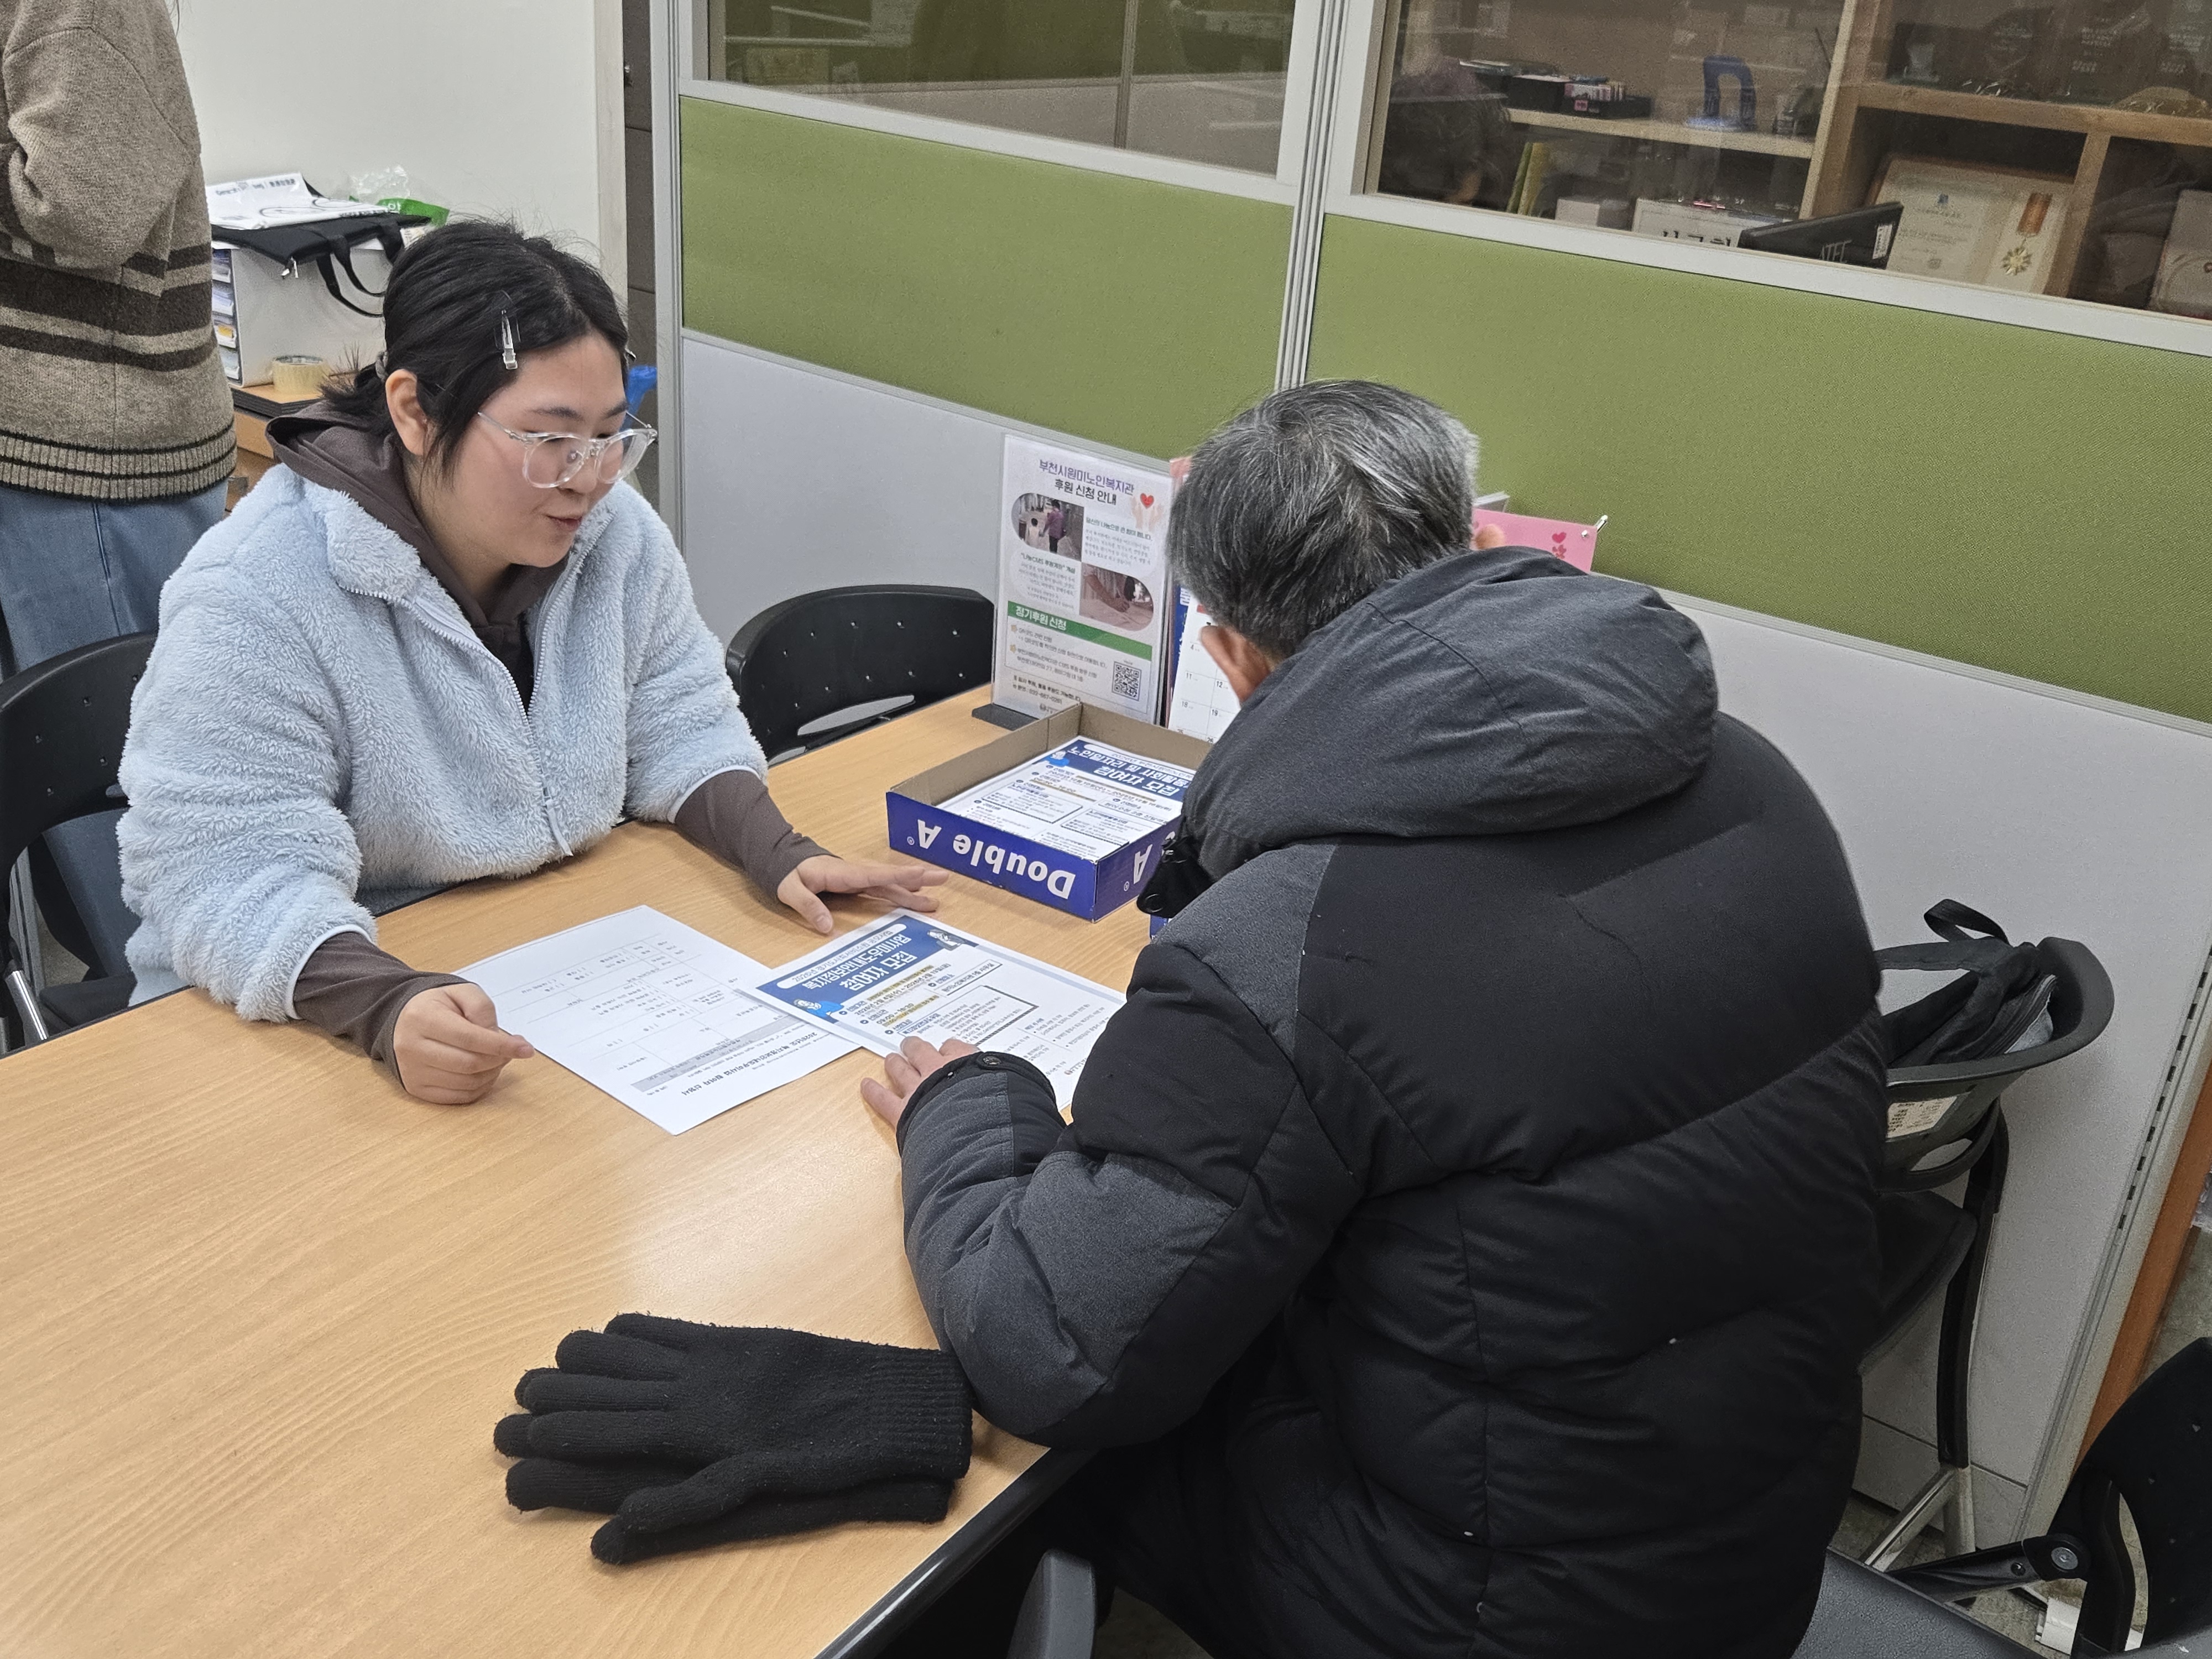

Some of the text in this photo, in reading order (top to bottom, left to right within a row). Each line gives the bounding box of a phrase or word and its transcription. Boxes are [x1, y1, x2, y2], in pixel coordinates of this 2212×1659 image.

[1039, 460, 1134, 495] 부천시원미노인복지관
[1055, 479, 1117, 505] 후원 신청 안내
[1016, 606, 1067, 630] 정기후원 신청
[1067, 747, 1127, 768] 노인일자리
[1093, 766, 1145, 785] 참여자
[1142, 781, 1180, 796] 모집
[953, 834, 1076, 899] Double
[802, 934, 913, 989] 복지정보안내도우미사업
[839, 951, 917, 990] 참여자 모집
